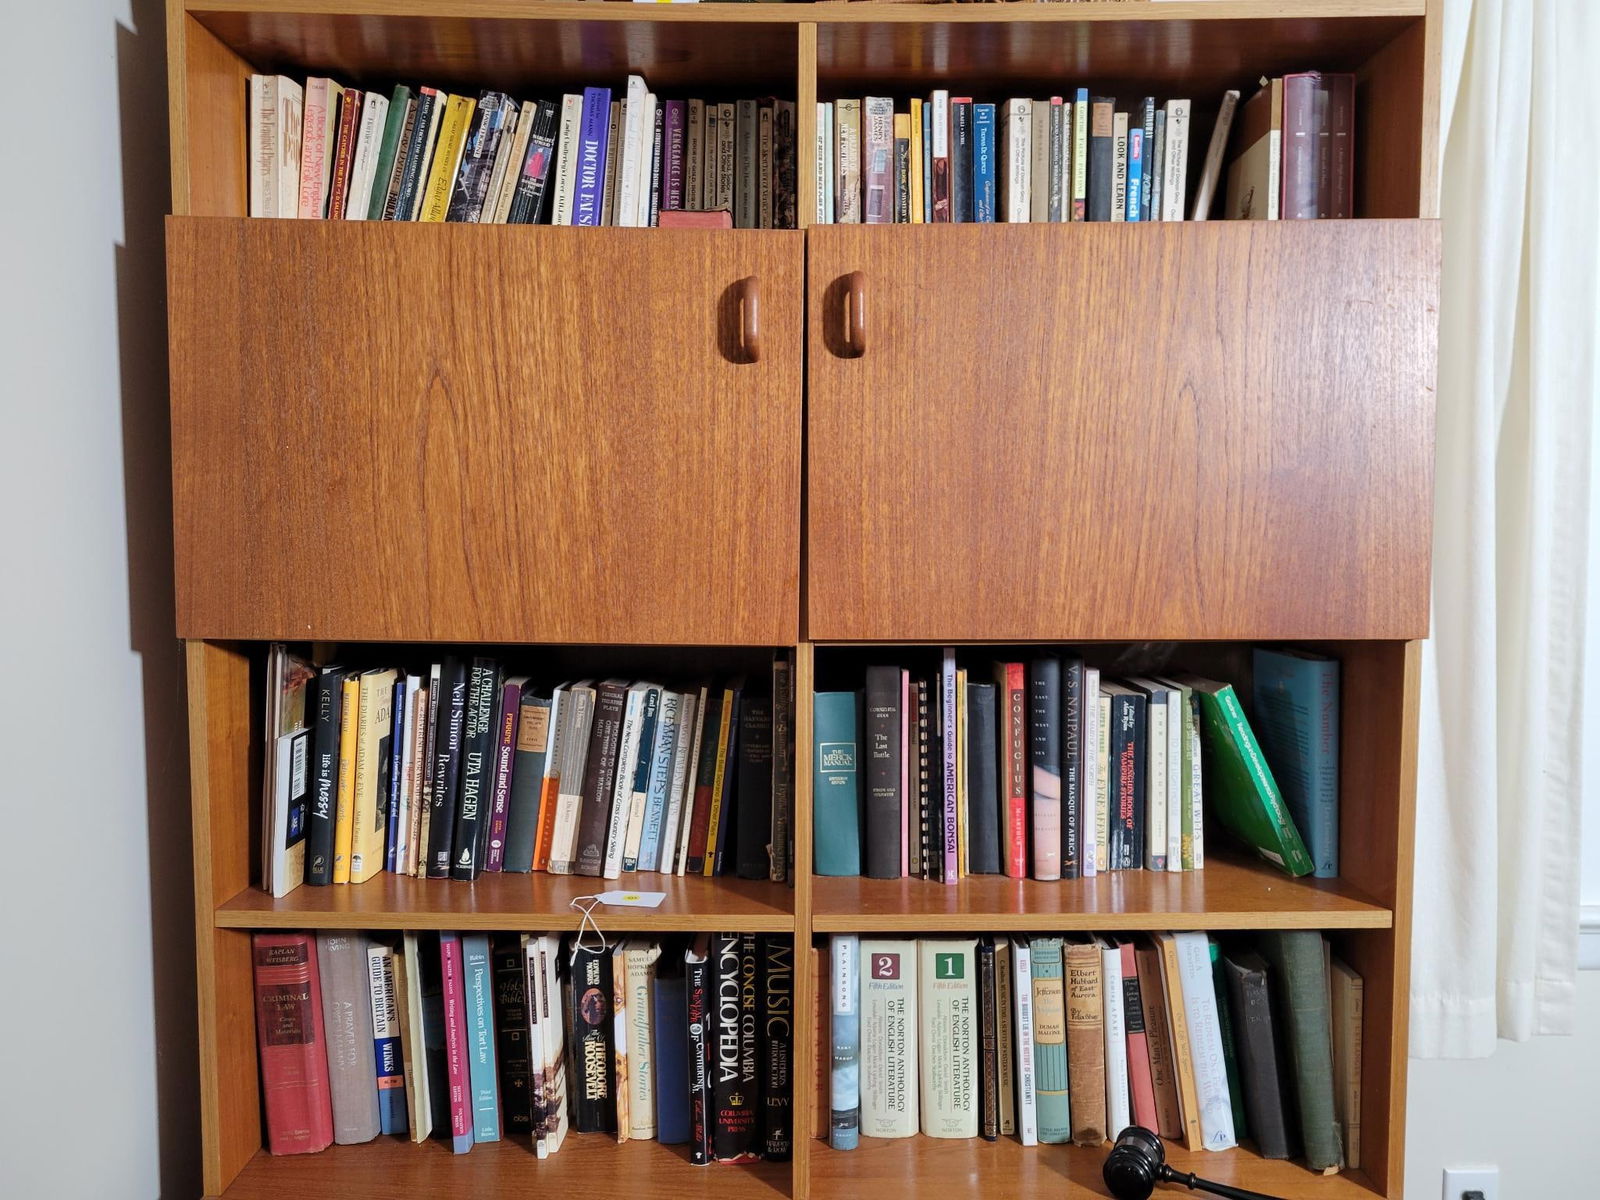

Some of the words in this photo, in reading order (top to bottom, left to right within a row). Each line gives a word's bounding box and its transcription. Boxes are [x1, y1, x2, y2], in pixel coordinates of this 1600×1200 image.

[262, 107, 275, 119] The
[304, 104, 317, 142] Legends
[1145, 105, 1154, 139] HEMINGWAY
[261, 122, 275, 150] Feminist
[316, 117, 325, 138] Book
[474, 111, 490, 157] HAWTHORNE
[305, 145, 315, 162] and
[316, 143, 324, 153] of
[340, 135, 348, 159] CATCHER
[671, 128, 681, 174] VENGEANCE
[257, 153, 275, 175] Papers
[303, 163, 314, 183] Folk
[315, 156, 323, 178] New
[581, 140, 599, 189] DOCTOR
[301, 186, 312, 207] Lore
[311, 181, 322, 218] England
[670, 190, 680, 210] HERS
[1116, 183, 1124, 210] LEARN
[1130, 178, 1139, 217] French
[470, 666, 482, 683] FOR
[482, 668, 493, 676] A
[1067, 665, 1078, 677] V.
[360, 687, 369, 703] THE
[451, 681, 465, 706] Neil
[468, 684, 480, 706] THE
[1067, 681, 1078, 693] S.
[320, 689, 330, 722] KELLY
[477, 678, 492, 733] CHALLENGE
[946, 688, 954, 729] Beginner's
[358, 704, 368, 737] DIARIES
[448, 710, 464, 750] Simon
[465, 709, 478, 738] ACTOR
[503, 713, 514, 744] PERRINE
[626, 719, 634, 730] The
[661, 697, 678, 755] RICEYMAN
[1066, 696, 1078, 759] NAIPAUL
[624, 732, 632, 744] New
[946, 731, 954, 751] Guide
[1013, 693, 1021, 795] CONFUCIUS
[322, 754, 331, 768] life
[356, 746, 366, 771] ADAM
[466, 751, 482, 776] UTA
[499, 746, 511, 772] Sound
[618, 745, 630, 774] Complete
[946, 752, 953, 760] to
[1120, 751, 1128, 786] VAMPIRE
[321, 769, 329, 777] is
[434, 754, 450, 808] Rewrites
[498, 773, 508, 789] and
[618, 775, 626, 790] Book
[654, 756, 671, 794] STEPS
[1068, 767, 1076, 783] THE
[1127, 759, 1135, 794] PENGUIN
[355, 783, 364, 799] EVE
[946, 761, 954, 813] AMERICAN
[1068, 783, 1076, 815] MASQUE
[1096, 778, 1105, 808] EYRE
[462, 779, 480, 821] HAGEN
[495, 789, 507, 814] Sense
[614, 798, 624, 815] Cross
[1126, 795, 1134, 817] BOOK
[610, 815, 621, 840] Country
[647, 796, 662, 843] BENNETT
[1068, 816, 1075, 827] OF
[1096, 810, 1105, 847] AFFAIR
[1126, 818, 1133, 829] OF
[946, 816, 955, 854] BONSAI
[608, 841, 617, 859] Skiing
[372, 956, 382, 982] GUIDE
[382, 956, 392, 970] AN
[878, 957, 893, 977] 2
[944, 957, 956, 975] 1
[374, 983, 383, 997] TO
[474, 968, 486, 1016] Perspectives
[742, 956, 755, 1011] CONCISE
[766, 945, 792, 1037] MUSIC
[263, 993, 309, 1001] CRIMINAL
[383, 971, 395, 1022] AMERICAN'S
[448, 999, 456, 1017] Writing
[887, 1001, 896, 1013] OF
[952, 999, 961, 1013] OF
[961, 997, 969, 1015] THE
[375, 998, 385, 1033] BRITAIN
[476, 1017, 485, 1028] on
[633, 985, 649, 1060] Grandfather
[450, 1027, 458, 1049] Analysis
[478, 1029, 487, 1045] Tort
[887, 1015, 896, 1052] ENGLISH
[896, 1017, 904, 1056] NORTON
[952, 1015, 961, 1052] ENGLISH
[961, 1016, 969, 1056] NORTON
[382, 1042, 393, 1073] WINKS
[479, 1046, 488, 1064] Law
[742, 1015, 755, 1083] COLUMBIA
[584, 1041, 598, 1101] ROOSEVELT
[595, 1041, 607, 1099] THEODORE
[639, 1061, 650, 1101] Stories
[953, 1055, 961, 1109] LITERATURE
[888, 1056, 896, 1110] LITERATURE
[767, 1097, 789, 1106] LEVY
